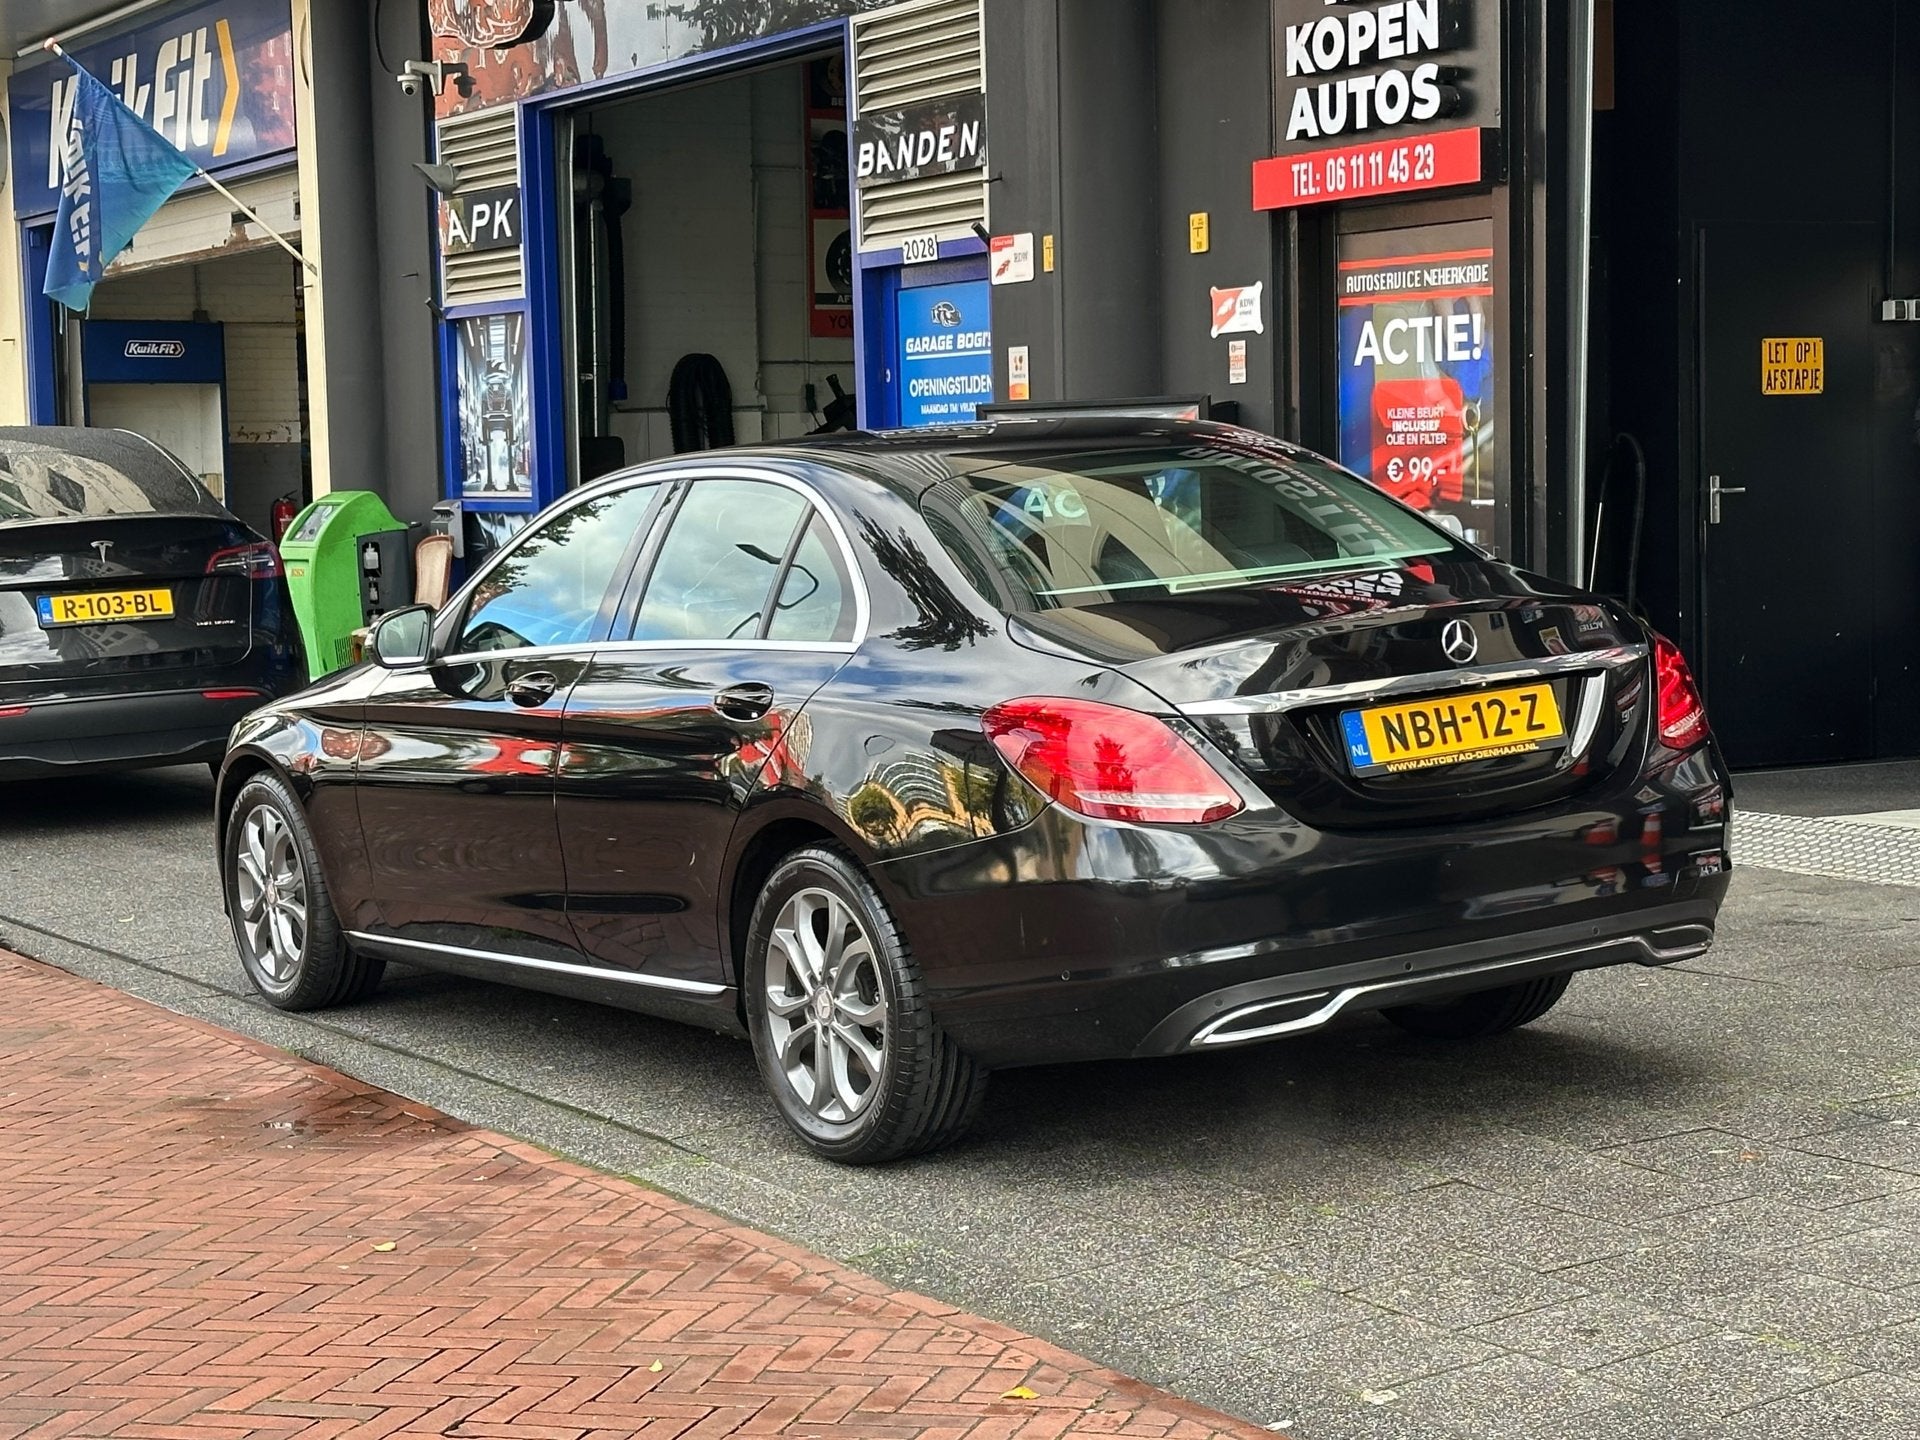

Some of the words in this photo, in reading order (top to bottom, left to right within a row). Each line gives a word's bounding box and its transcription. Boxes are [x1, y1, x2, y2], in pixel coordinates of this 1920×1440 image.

[1286, 0, 1439, 77] KOPEN
[1286, 62, 1440, 141] AUTOS
[857, 120, 980, 177] BANDEN
[1291, 162, 1320, 197] TEL:
[1326, 156, 1346, 193] 06
[1350, 153, 1364, 189] 11
[1369, 150, 1383, 186] 11
[1388, 147, 1409, 183] 45
[1414, 143, 1434, 181] 23
[447, 199, 513, 246] APK
[904, 237, 935, 260] 2028
[1346, 270, 1421, 293] AUTOSERVICE
[1424, 264, 1489, 287] NEHERKADE
[906, 333, 953, 353] GARAGE
[957, 331, 991, 349] BOGI
[1353, 313, 1482, 366] ACTIE!
[1768, 342, 1788, 364] LET
[1796, 341, 1816, 363] OP!
[1766, 368, 1820, 390] AFSTAPJE
[1387, 407, 1415, 420] KLEINE
[1417, 406, 1444, 419] BEURT
[1392, 420, 1440, 432] INCLUSIEF
[1406, 433, 1418, 445] EN
[1420, 432, 1447, 445] FILTER
[1387, 457, 1404, 482] €
[1409, 457, 1446, 486] 99,-
[62, 593, 162, 618] R-103-BL
[1381, 694, 1545, 753] NBH-12-Z
[1352, 744, 1369, 756] NL
[1386, 743, 1539, 773] WWW.AUTOSTAD-DENHAAG.NL
